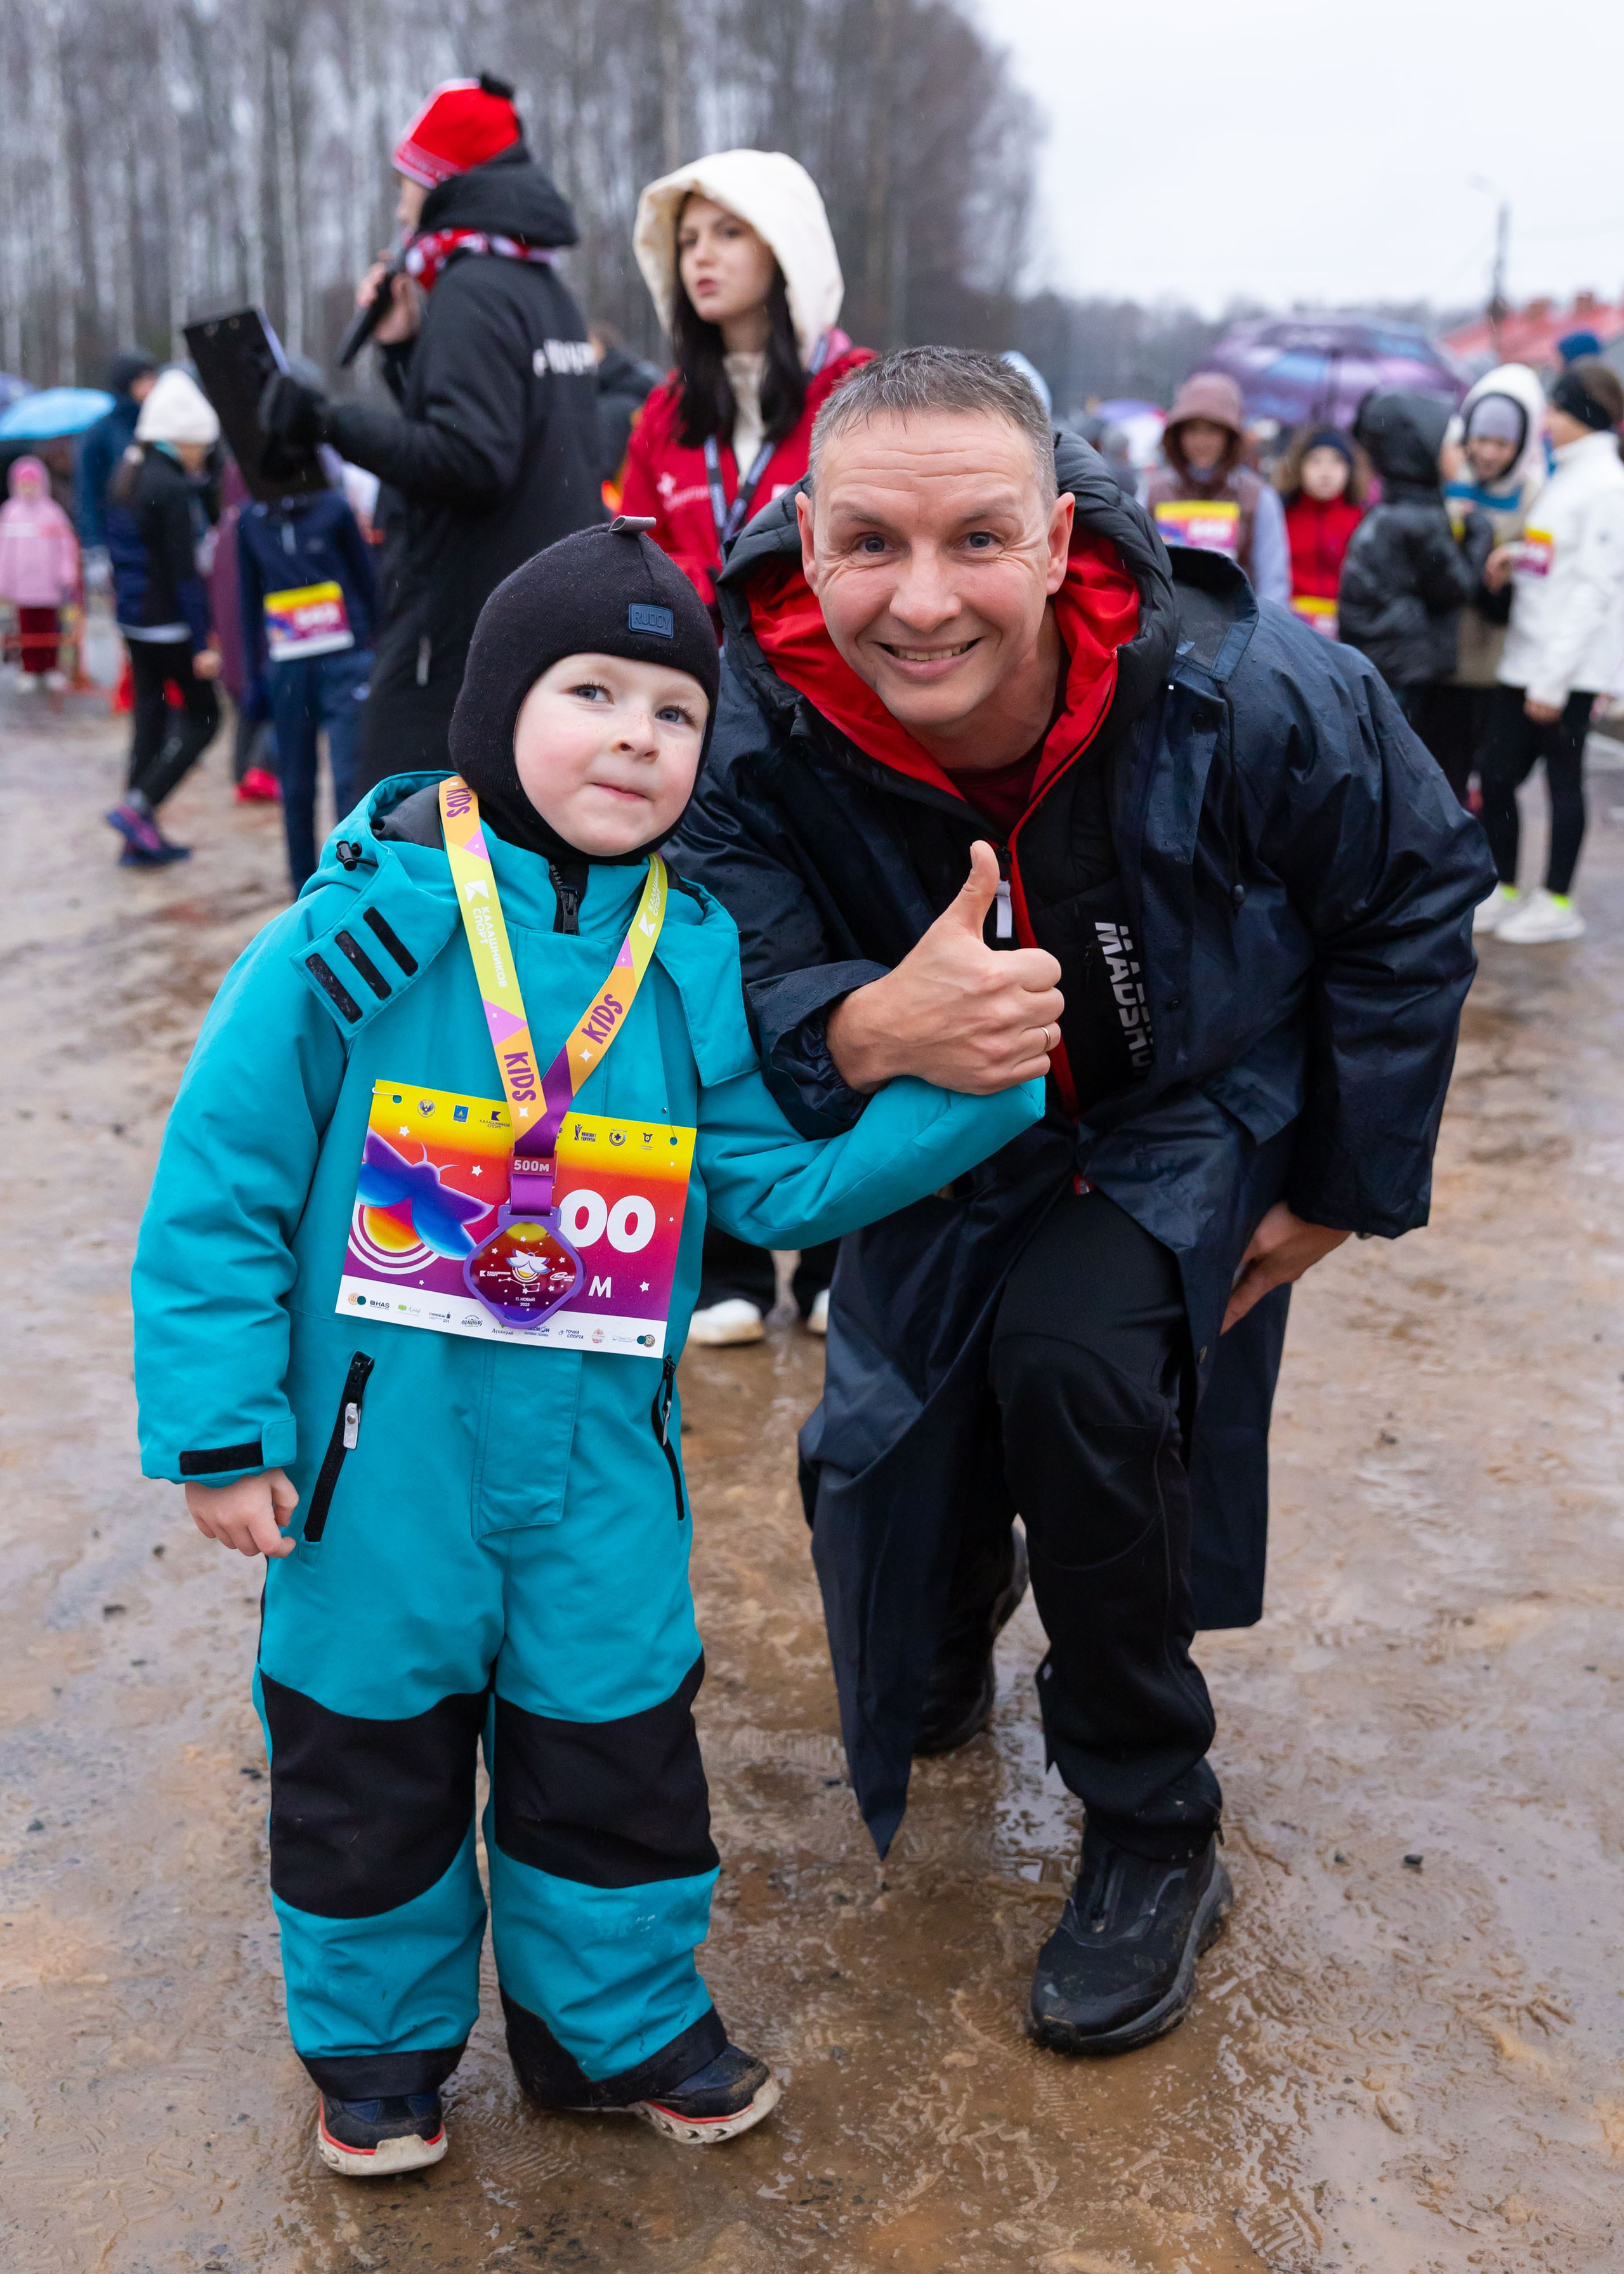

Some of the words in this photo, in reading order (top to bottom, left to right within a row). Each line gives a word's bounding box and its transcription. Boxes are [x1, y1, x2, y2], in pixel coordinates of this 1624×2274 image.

[634, 611, 671, 630] RUDDY
[446, 787, 473, 818] KIDS
[653, 888, 662, 916] СПОРТ
[473, 907, 489, 945] СПОРТ
[481, 906, 508, 988] КАЛАШНИКОВ
[1094, 922, 1155, 1070] MADSHU
[581, 993, 623, 1045] KIDS
[504, 1051, 537, 1101] KIDS
[479, 1119, 510, 1127] КАЛАШНИКОВ
[556, 1188, 657, 1254] 00
